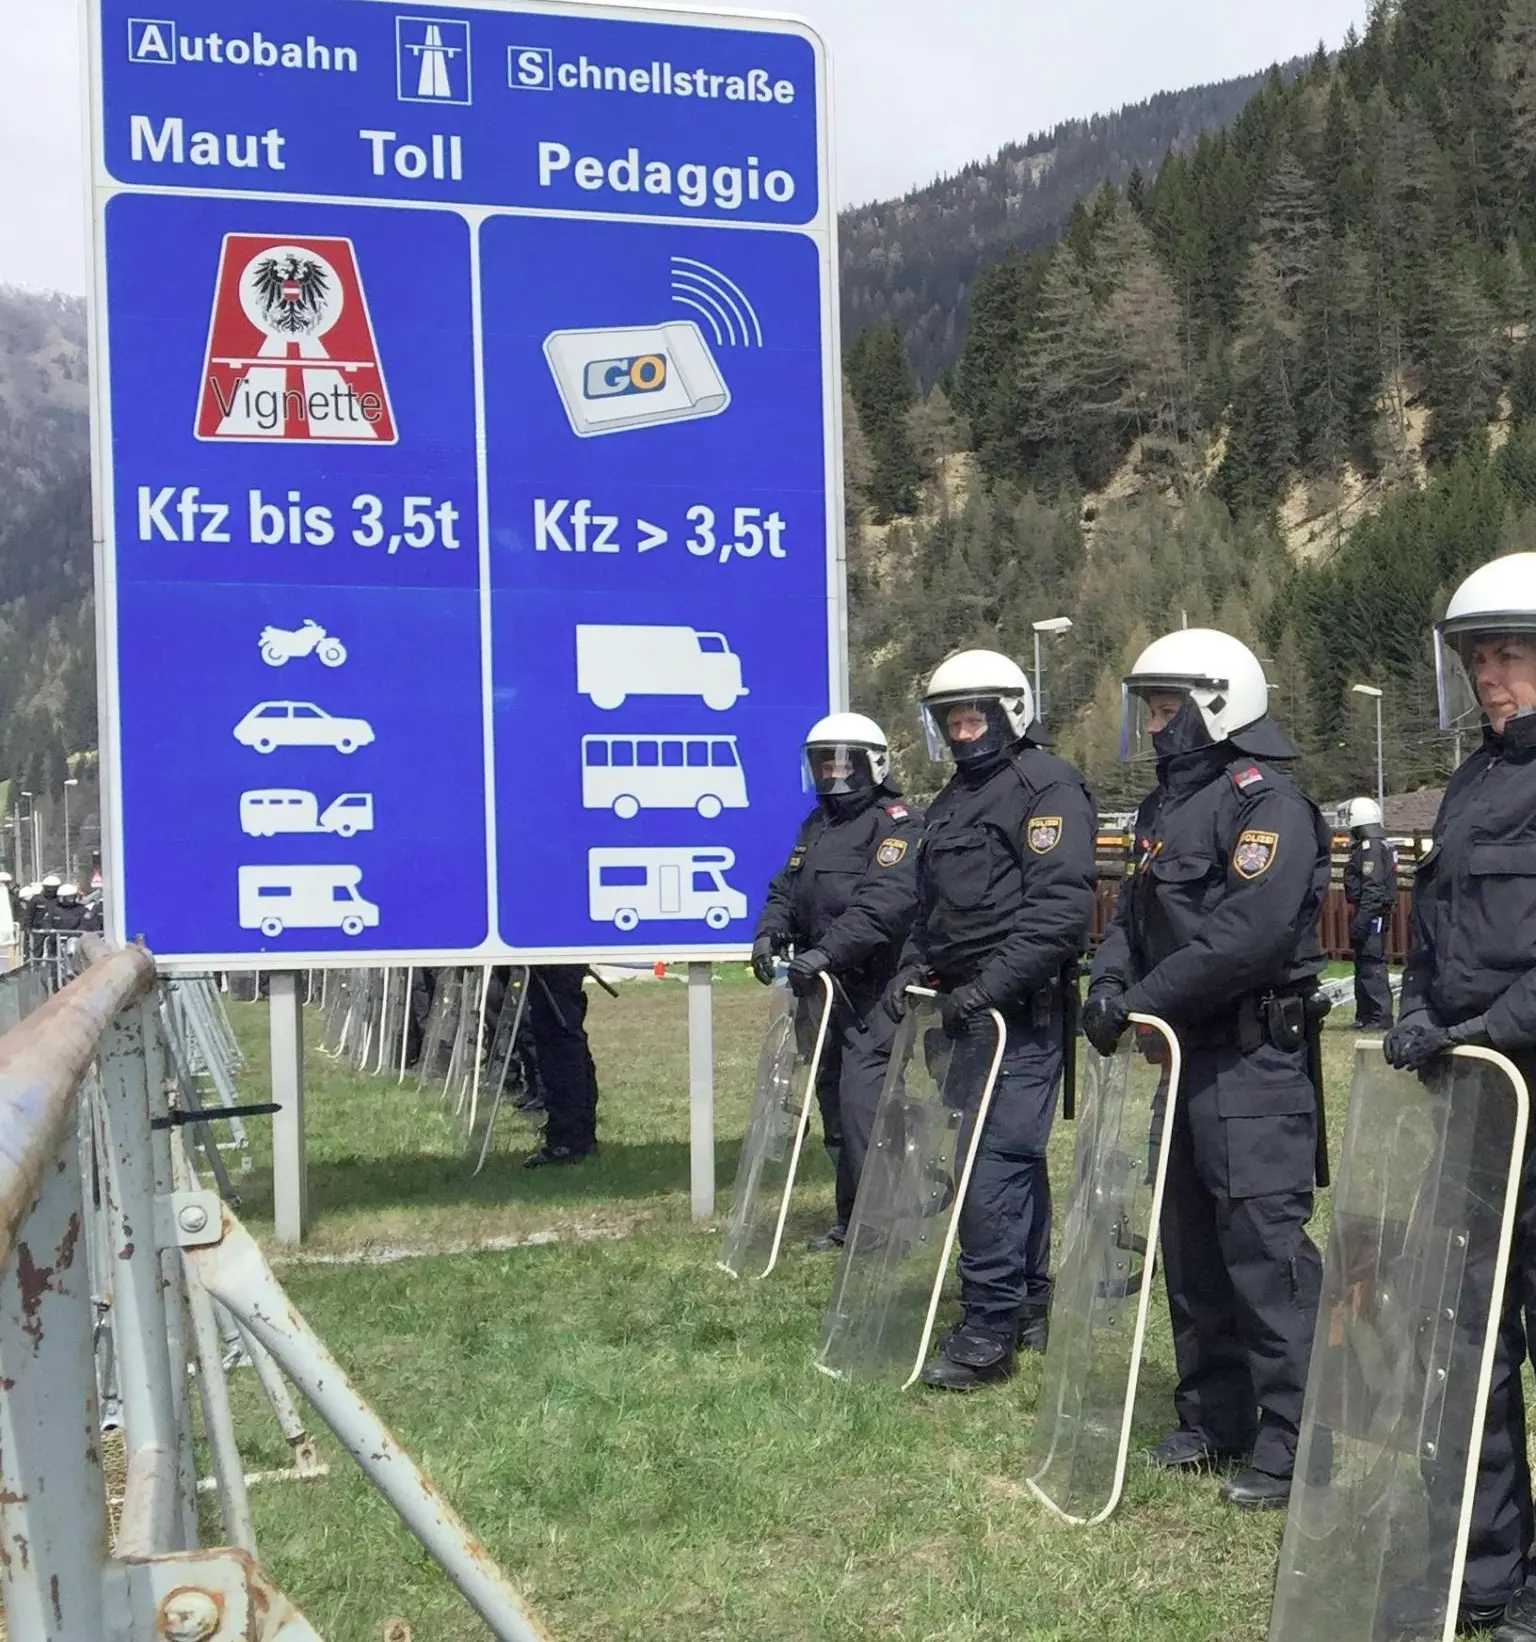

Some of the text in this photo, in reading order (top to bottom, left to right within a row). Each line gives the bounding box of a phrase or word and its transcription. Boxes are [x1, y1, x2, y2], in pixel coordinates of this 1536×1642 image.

[135, 24, 357, 72] Autobahn
[516, 51, 795, 104] Schnellstraße
[130, 116, 795, 208] Maut Toll Pedaggio
[597, 354, 666, 394] GO
[209, 376, 382, 429] Vignette
[138, 487, 460, 554] Kfz bis 3,5t
[534, 499, 786, 562] Kfz > 3,5t
